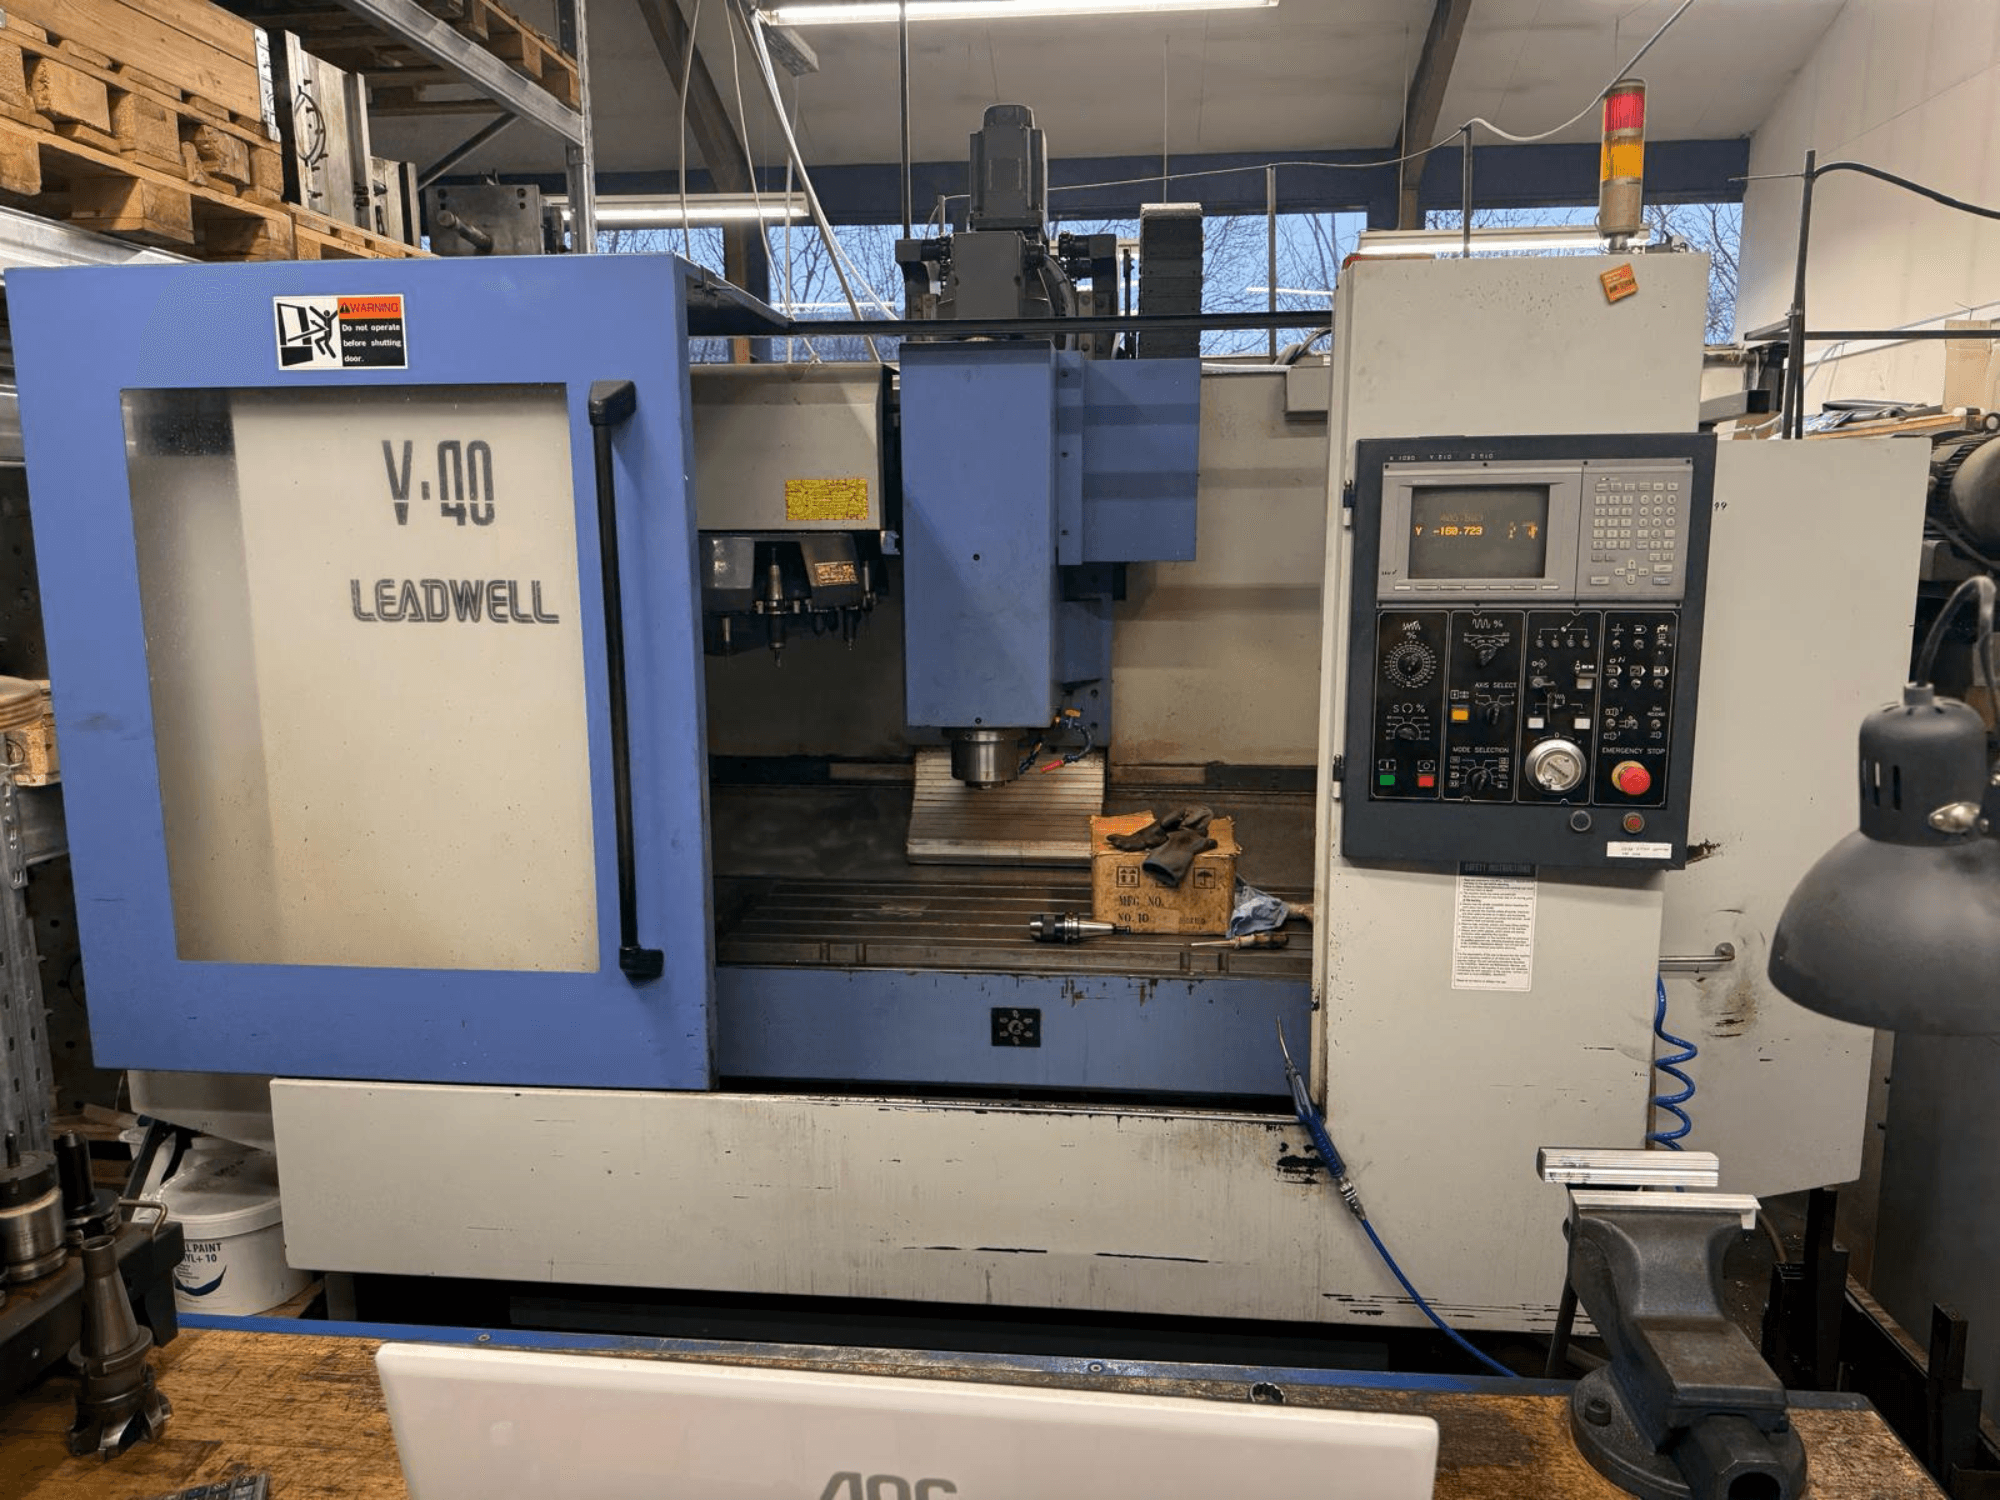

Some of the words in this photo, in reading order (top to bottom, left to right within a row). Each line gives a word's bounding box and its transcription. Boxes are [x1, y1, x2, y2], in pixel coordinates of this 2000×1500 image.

[349, 302, 399, 313] WARNING
[341, 323, 353, 332] Do
[355, 323, 368, 332] not
[370, 323, 401, 334] operate
[342, 338, 367, 347] before
[370, 338, 402, 349] shutting
[344, 353, 365, 363] door.
[350, 578, 560, 624] LEADWELL
[1474, 681, 1490, 689] AXIS
[1493, 681, 1517, 689] SELECT
[1474, 746, 1510, 754] SELECTION
[1601, 746, 1644, 755] EMERGENCY
[193, 1242, 222, 1253] PAINT
[205, 1253, 217, 1263] 10
